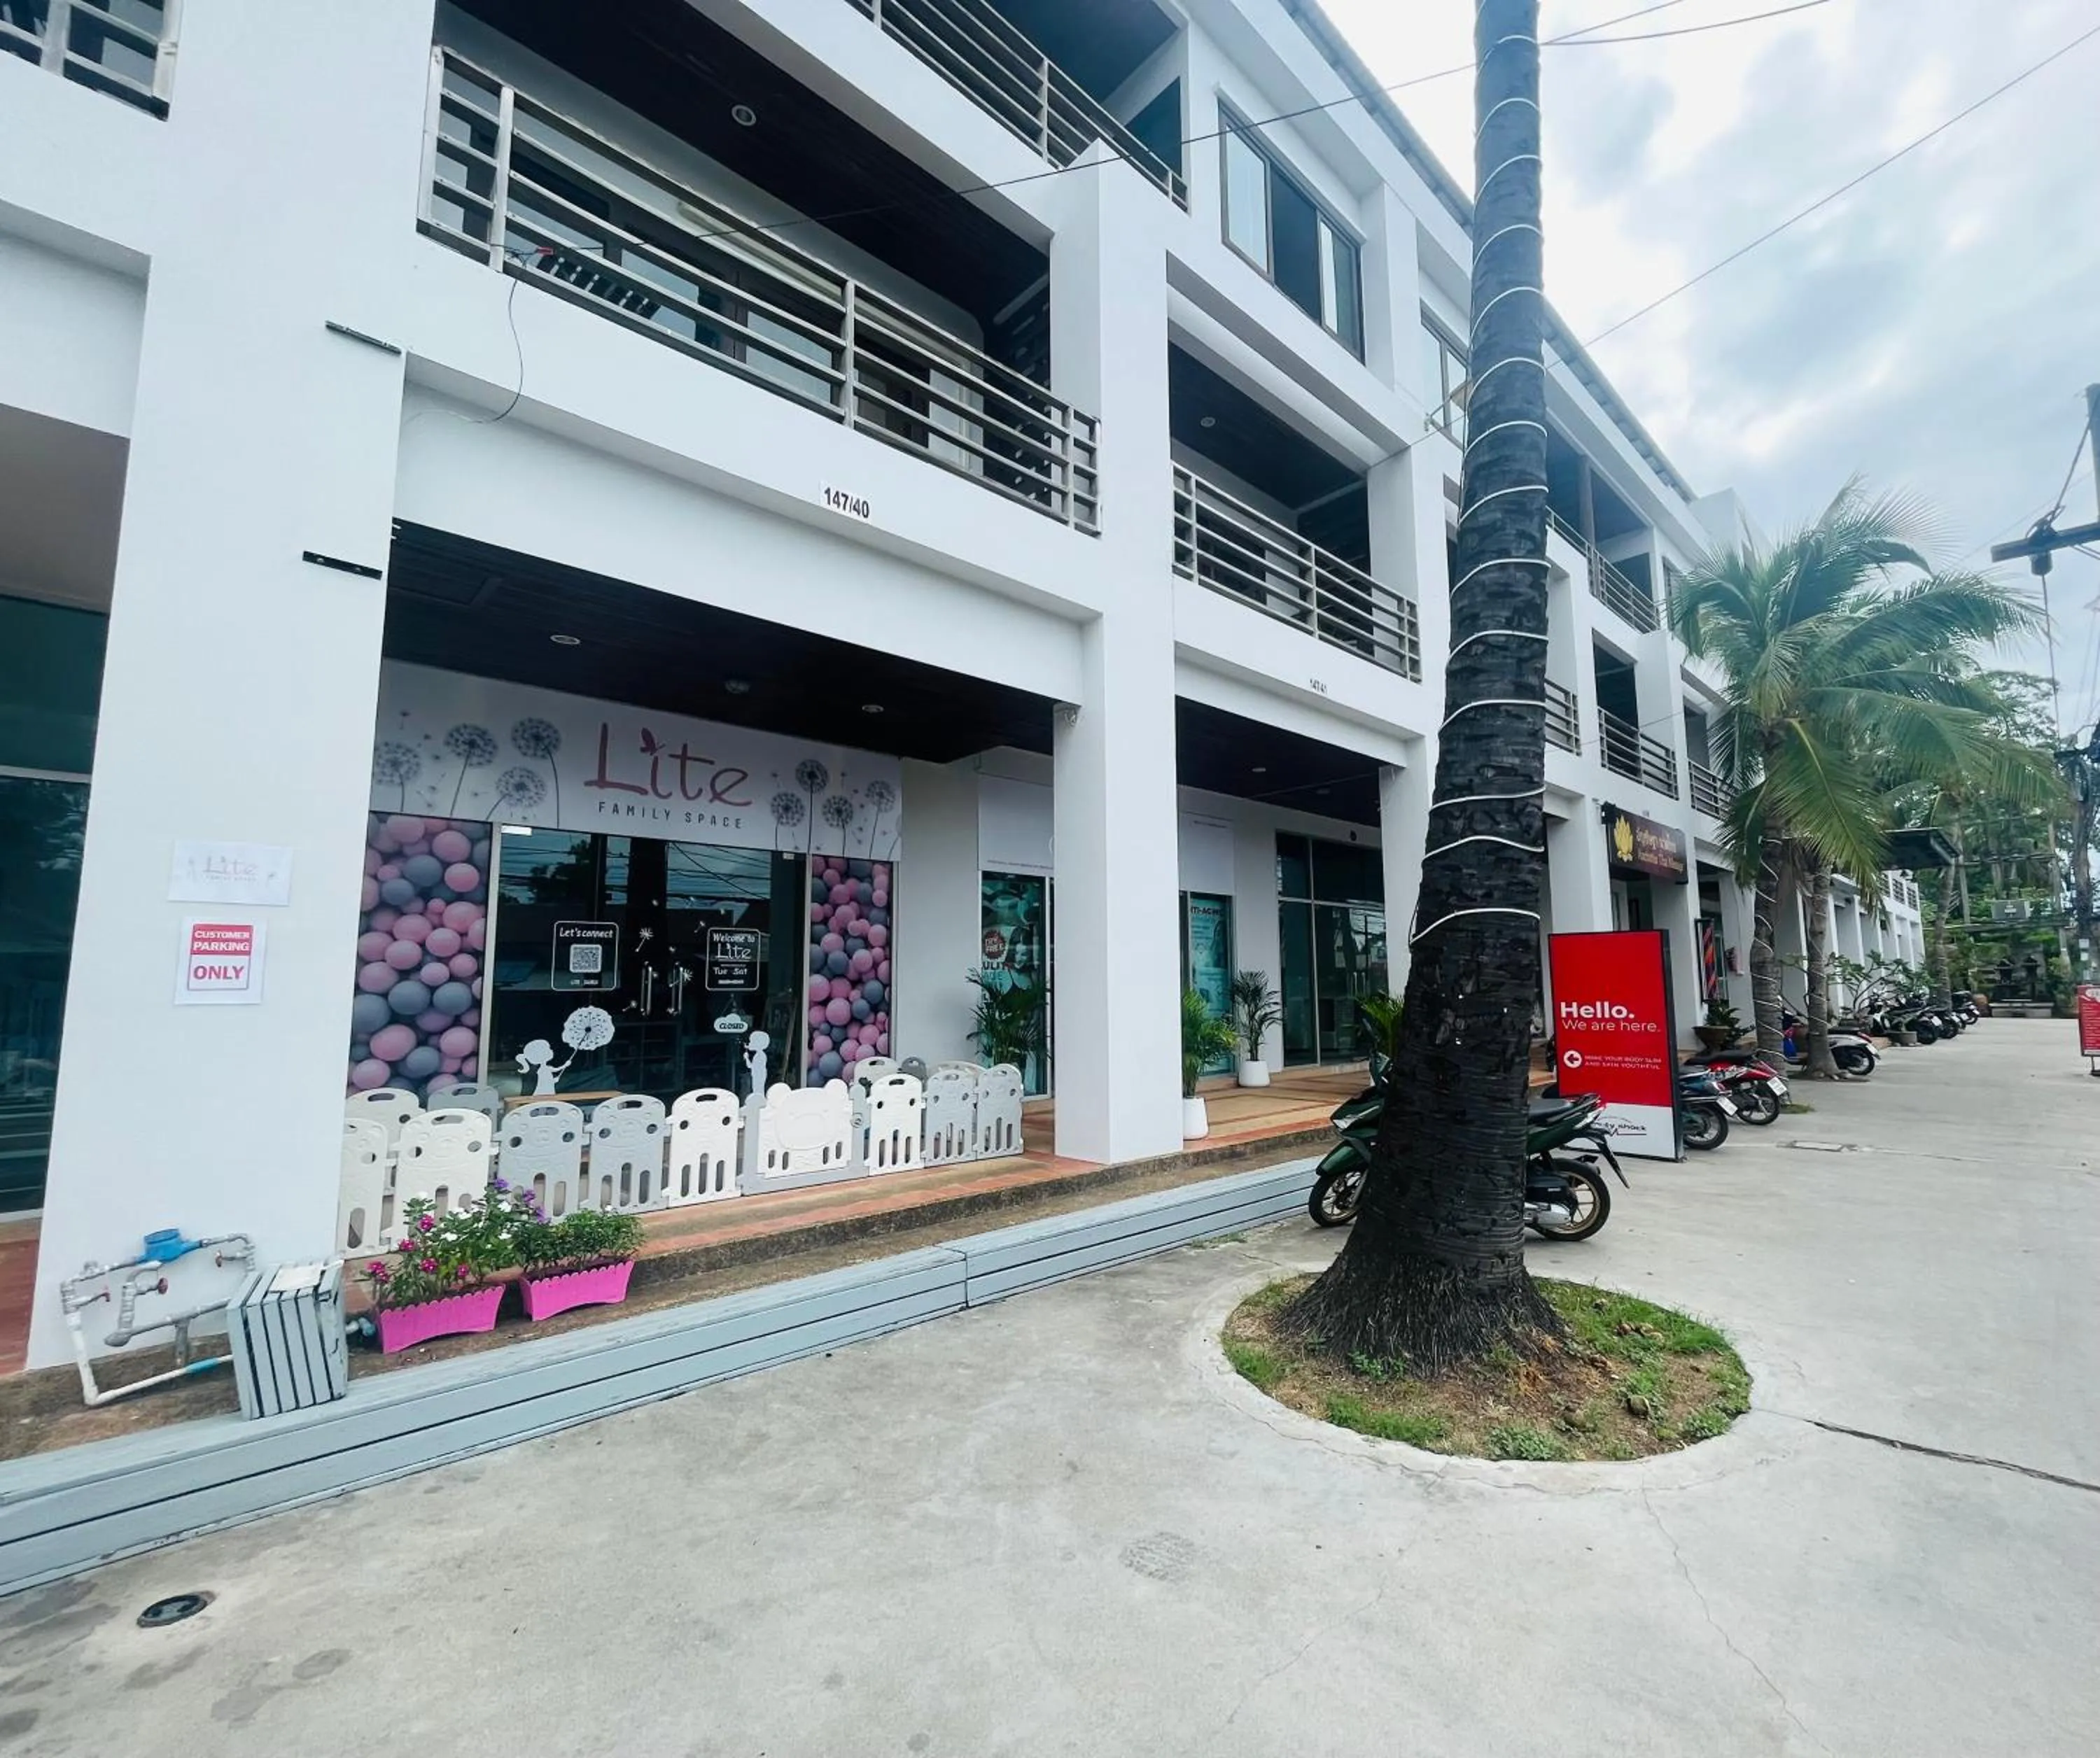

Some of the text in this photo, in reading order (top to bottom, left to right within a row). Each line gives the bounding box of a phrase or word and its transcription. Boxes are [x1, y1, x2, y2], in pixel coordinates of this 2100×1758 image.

[824, 486, 869, 519] 147/40
[584, 722, 752, 807] Lite
[598, 801, 742, 829] FAMILY SPACE
[194, 930, 250, 939] CUSTOMER
[559, 927, 613, 938] Let's connect
[713, 932, 743, 943] Welcome
[192, 941, 250, 952] PARKING
[715, 943, 752, 959] Lite
[193, 965, 244, 980] ONLY
[1560, 1001, 1635, 1019] Hello.
[719, 1022, 744, 1030] CLOSED
[1562, 1019, 1661, 1033] We are here.
